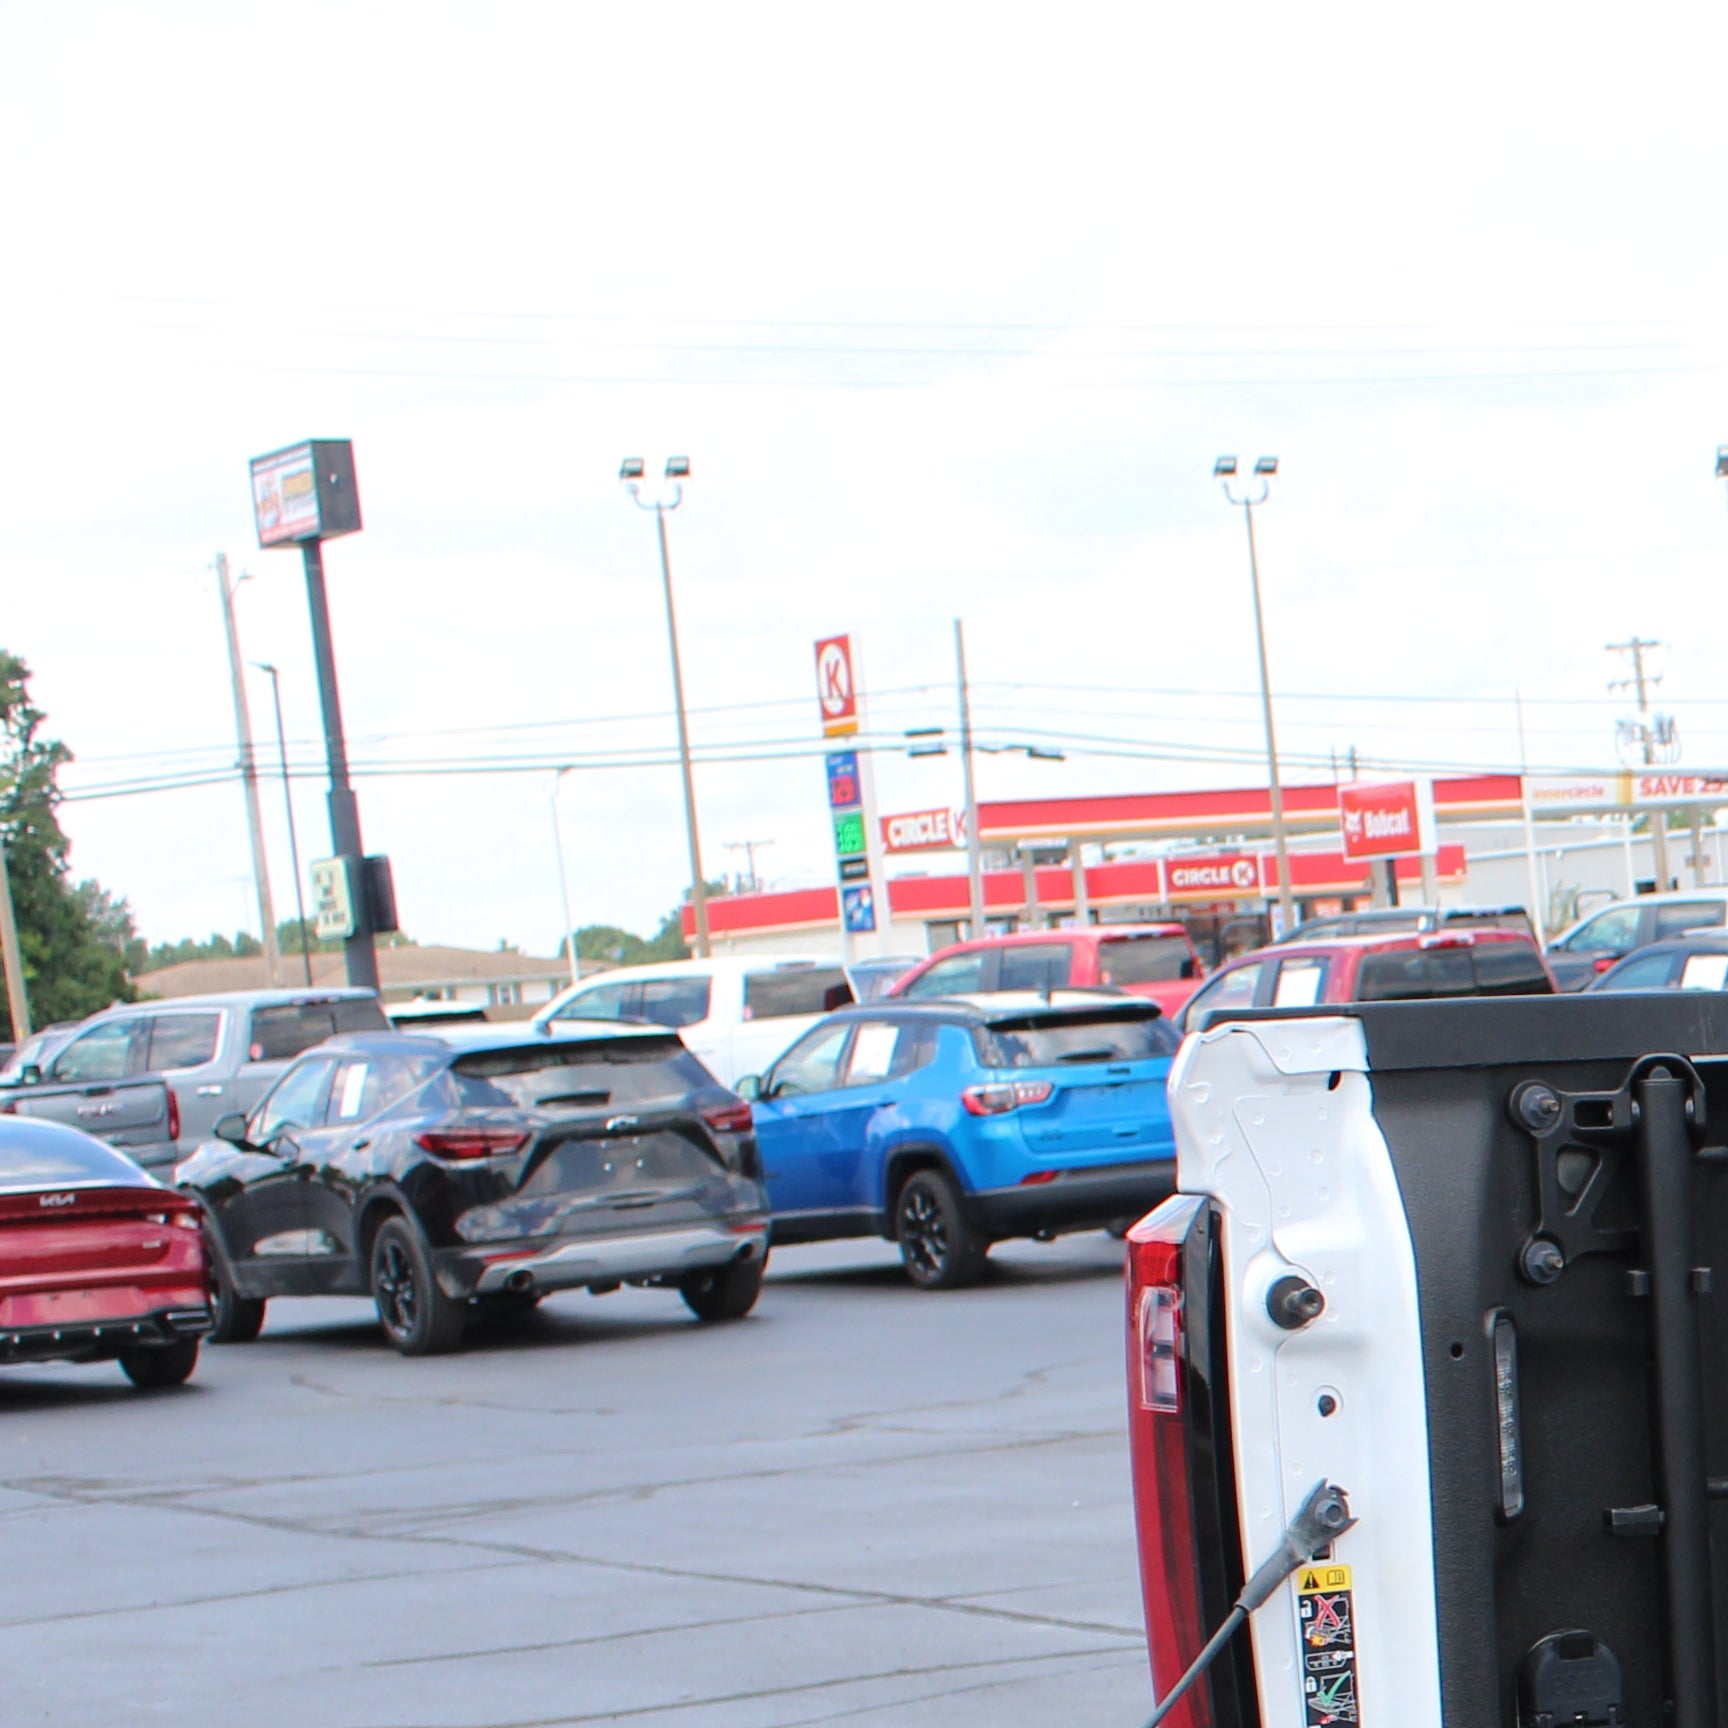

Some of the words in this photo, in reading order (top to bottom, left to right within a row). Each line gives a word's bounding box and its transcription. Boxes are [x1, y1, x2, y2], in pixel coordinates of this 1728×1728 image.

[825, 658, 846, 700] K
[1640, 775, 1696, 797] SAVE
[888, 811, 949, 848] CIRCLE
[1363, 807, 1411, 839] Bobcat
[1171, 865, 1230, 888] CIRCLE
